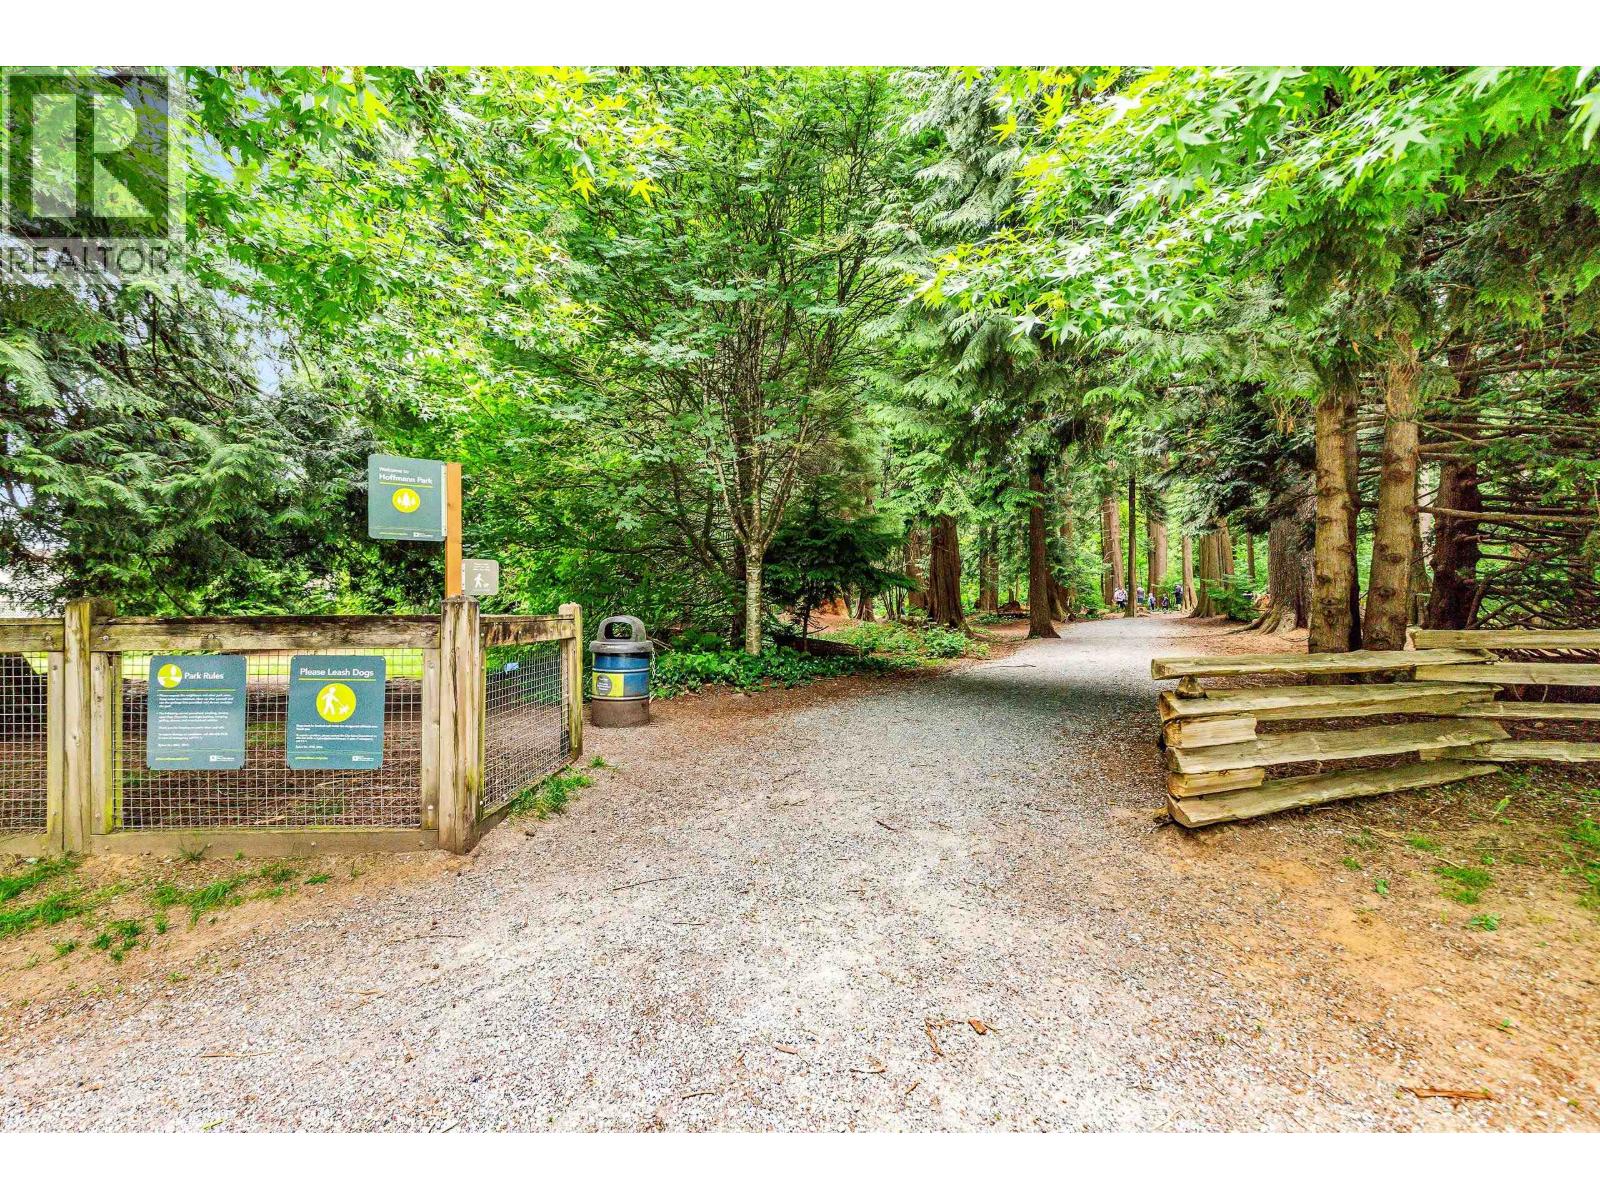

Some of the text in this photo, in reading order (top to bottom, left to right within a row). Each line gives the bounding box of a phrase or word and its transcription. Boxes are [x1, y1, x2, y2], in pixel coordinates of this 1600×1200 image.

[379, 473, 433, 485] Hoffmann Park
[184, 672, 224, 680] Park Rules
[300, 668, 374, 678] Please Leash Dogs
